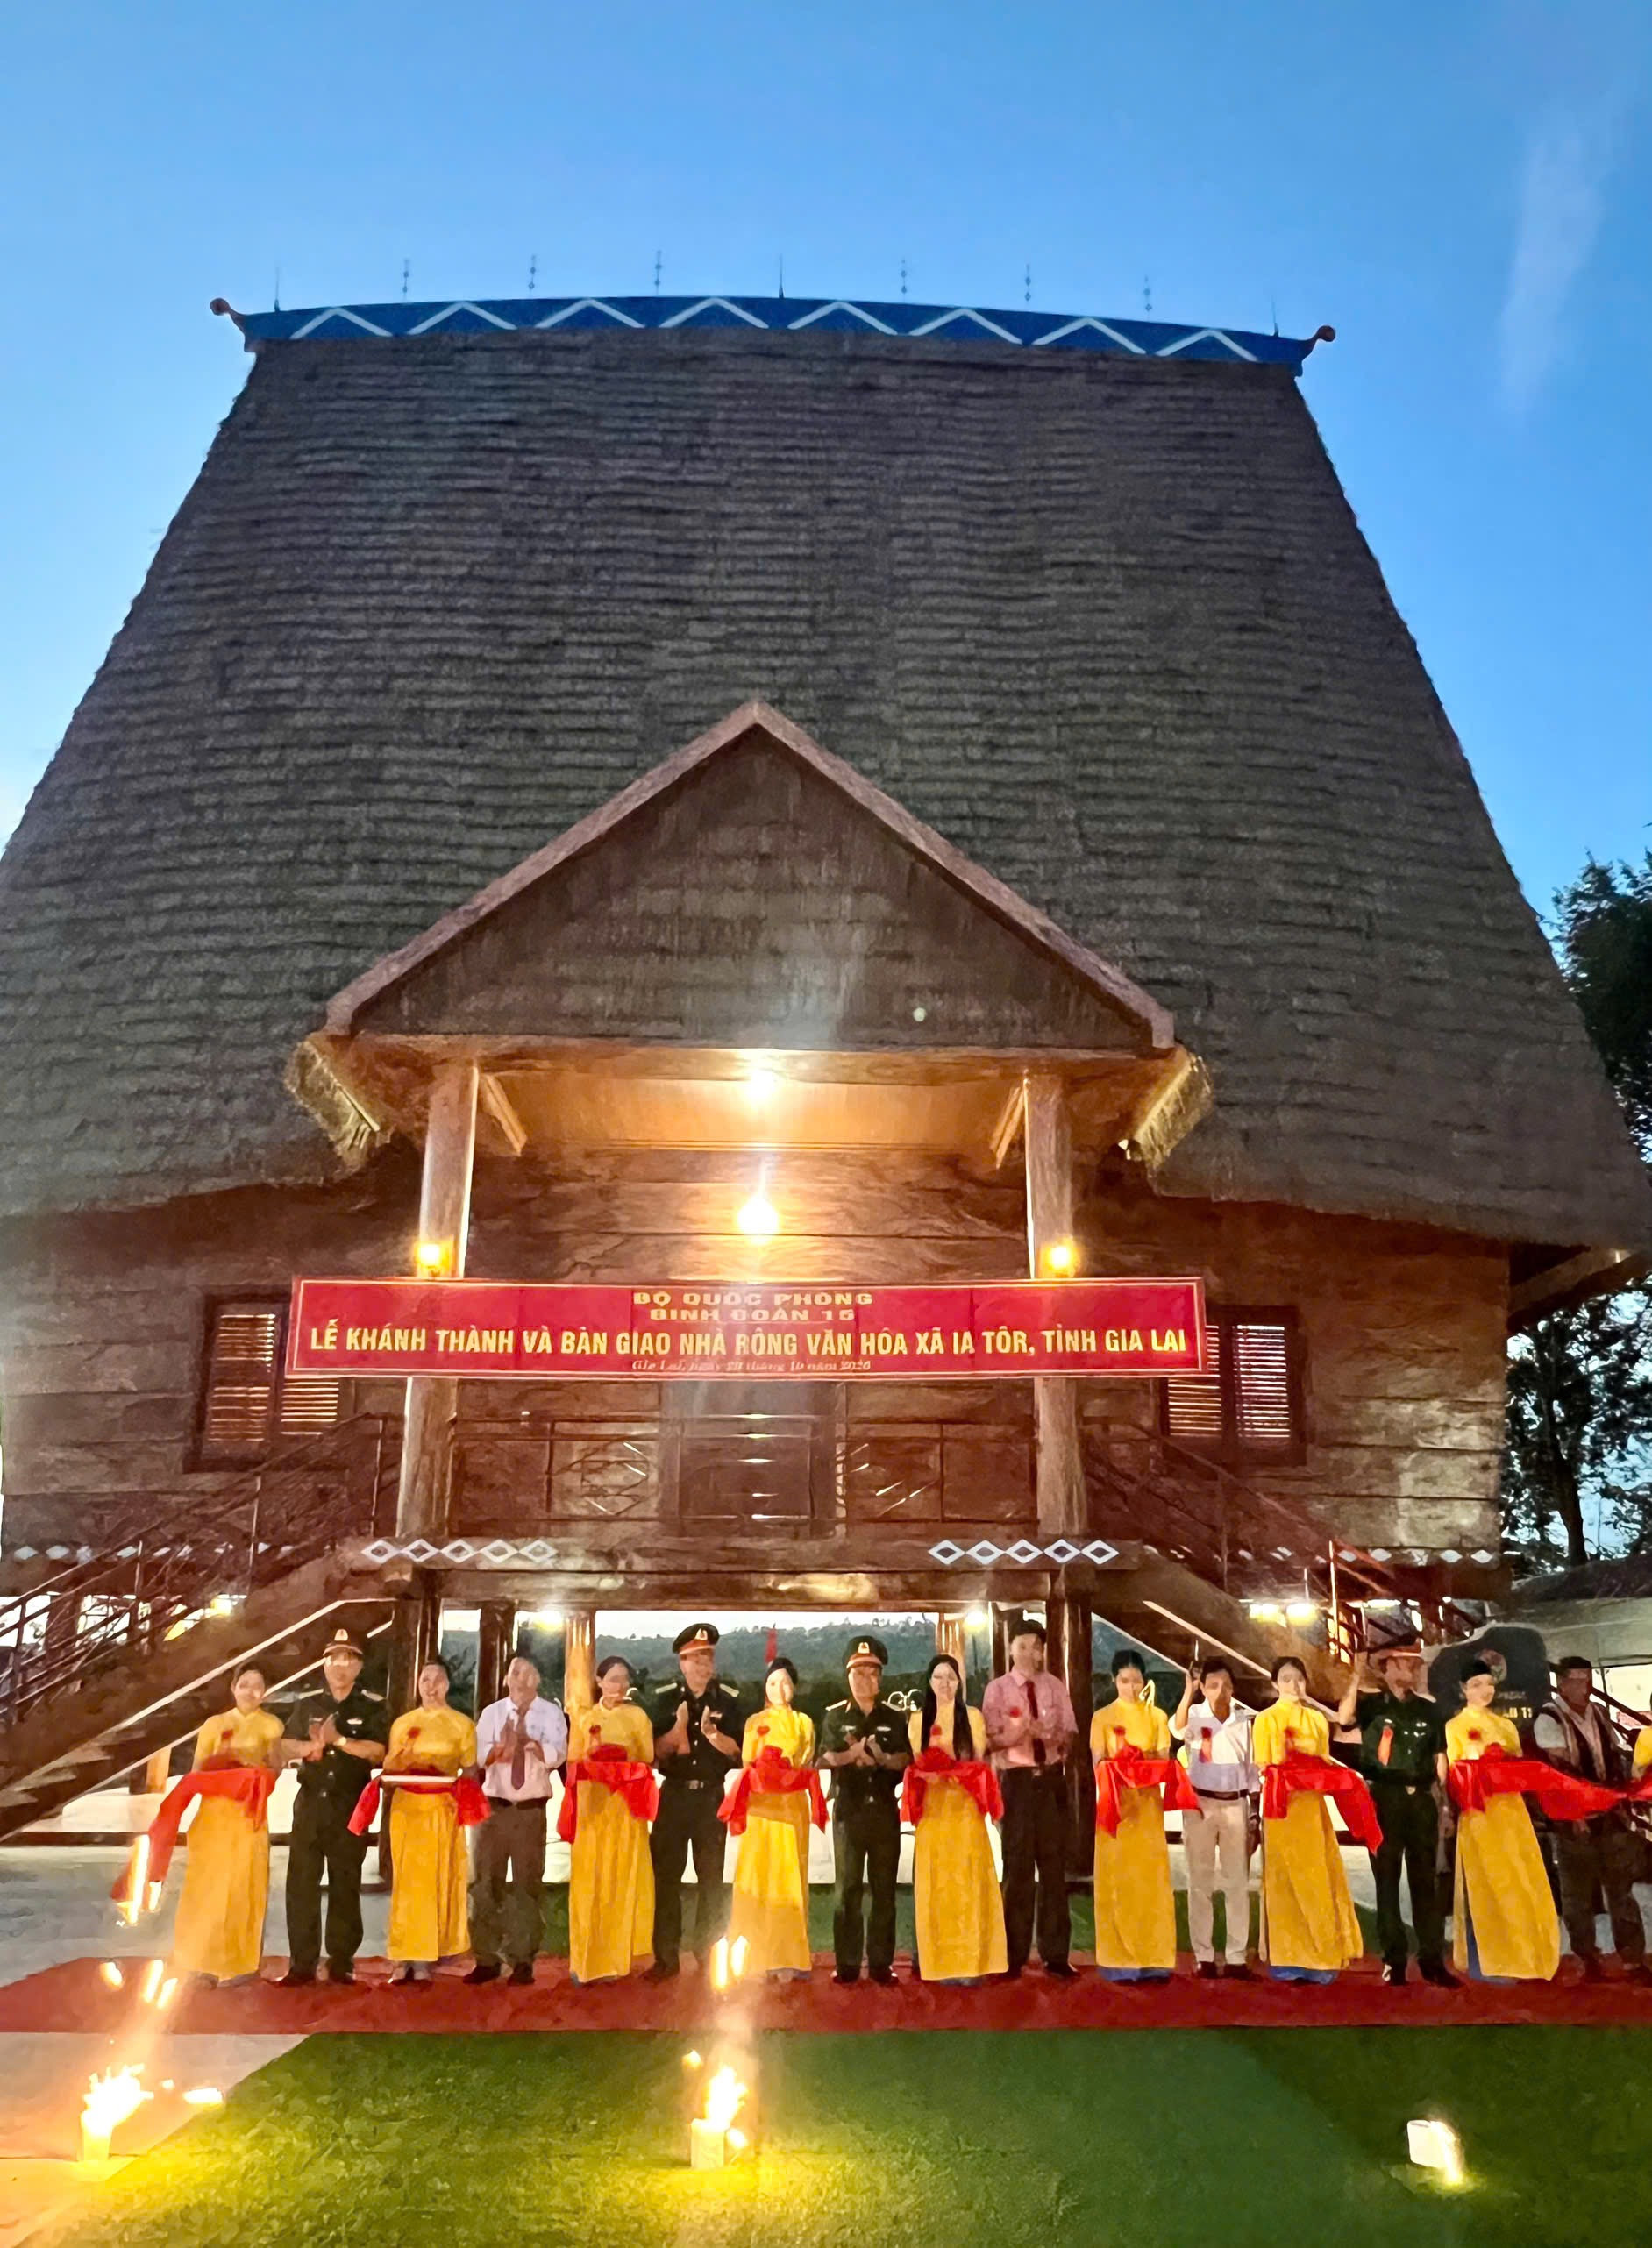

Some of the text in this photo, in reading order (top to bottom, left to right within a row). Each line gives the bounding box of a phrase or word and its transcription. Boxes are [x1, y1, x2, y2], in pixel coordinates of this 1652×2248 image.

[346, 1322, 427, 1352] KHÁNH
[435, 1324, 515, 1354] THÀNH
[523, 1325, 552, 1354] VÀ
[560, 1326, 608, 1355] BÀN
[616, 1331, 671, 1355] GIAO
[680, 1327, 727, 1355] NHÀ
[735, 1327, 798, 1355] RÔNG
[806, 1328, 851, 1355] VĂN
[915, 1327, 944, 1355] XÃ
[952, 1331, 976, 1355] IA
[981, 1325, 1036, 1356] TÔR,
[1105, 1329, 1143, 1352] GIA
[1150, 1329, 1186, 1352] LAI
